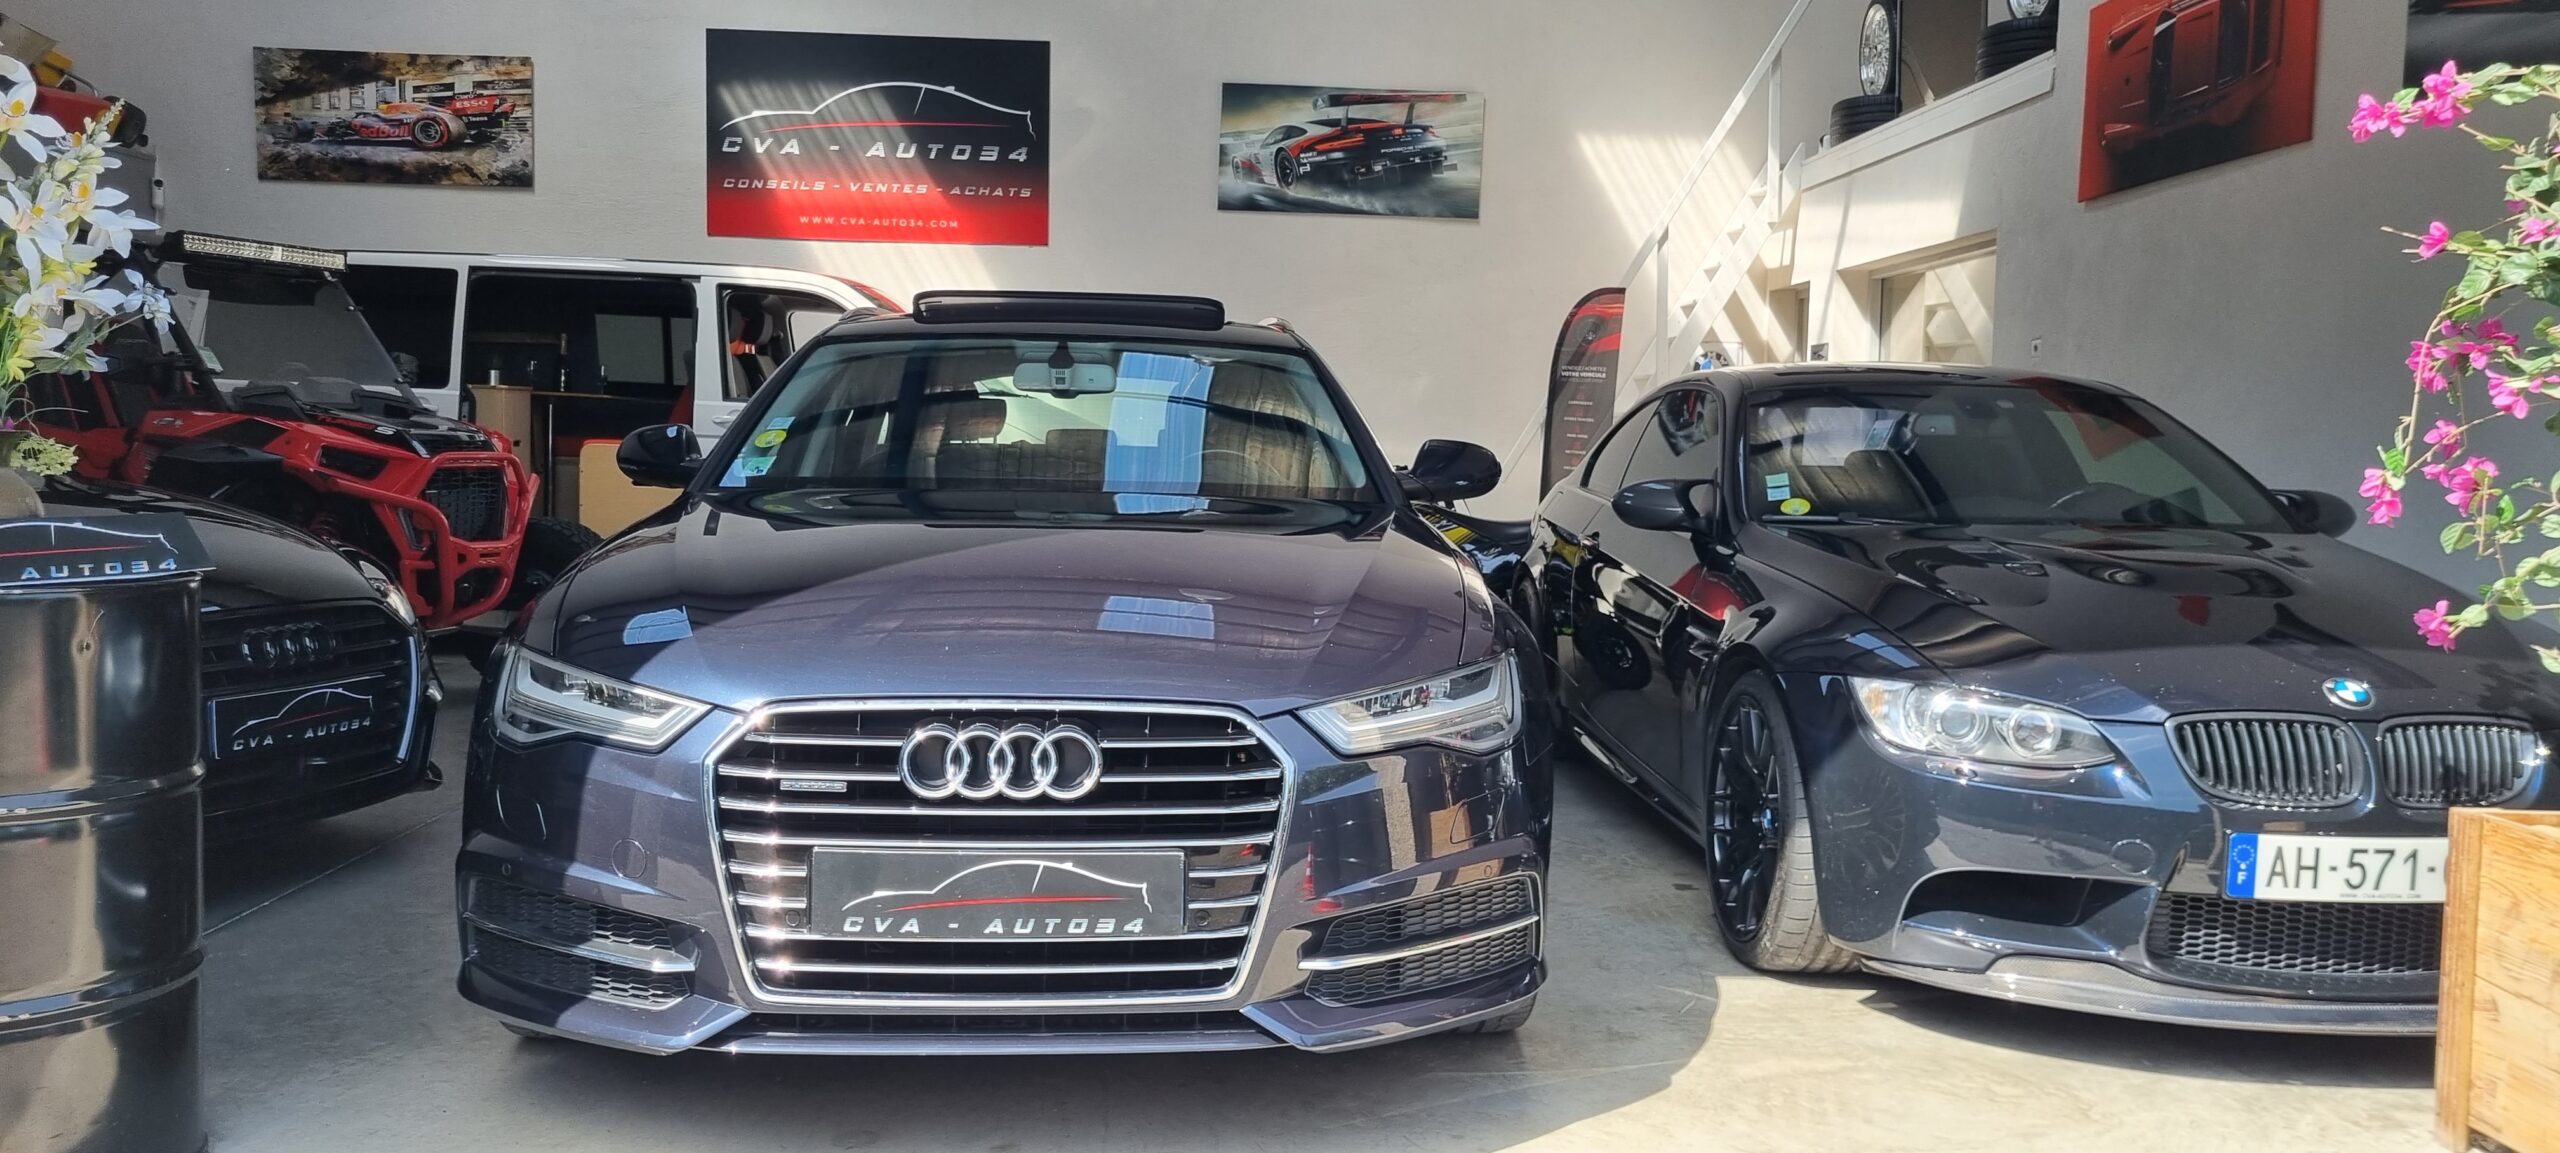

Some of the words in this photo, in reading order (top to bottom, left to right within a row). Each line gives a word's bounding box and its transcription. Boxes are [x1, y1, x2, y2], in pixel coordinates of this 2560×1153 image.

[455, 99, 489, 109] ESSO
[721, 136, 801, 156] CVA
[864, 141, 1029, 163] AUTO34
[722, 177, 826, 191] CONSEILS
[849, 181, 929, 195] VENTES
[949, 185, 1033, 198] ACHATS
[799, 215, 959, 229] WWW.CVA-AUTO34.COM
[20, 558, 178, 580] AUTO34
[232, 735, 274, 751] CVA
[304, 717, 371, 740] AUTO34
[2236, 871, 2248, 885] F
[2265, 845, 2448, 892] AH-571-
[842, 916, 921, 934] CVA
[983, 917, 1145, 934] AUTO34
